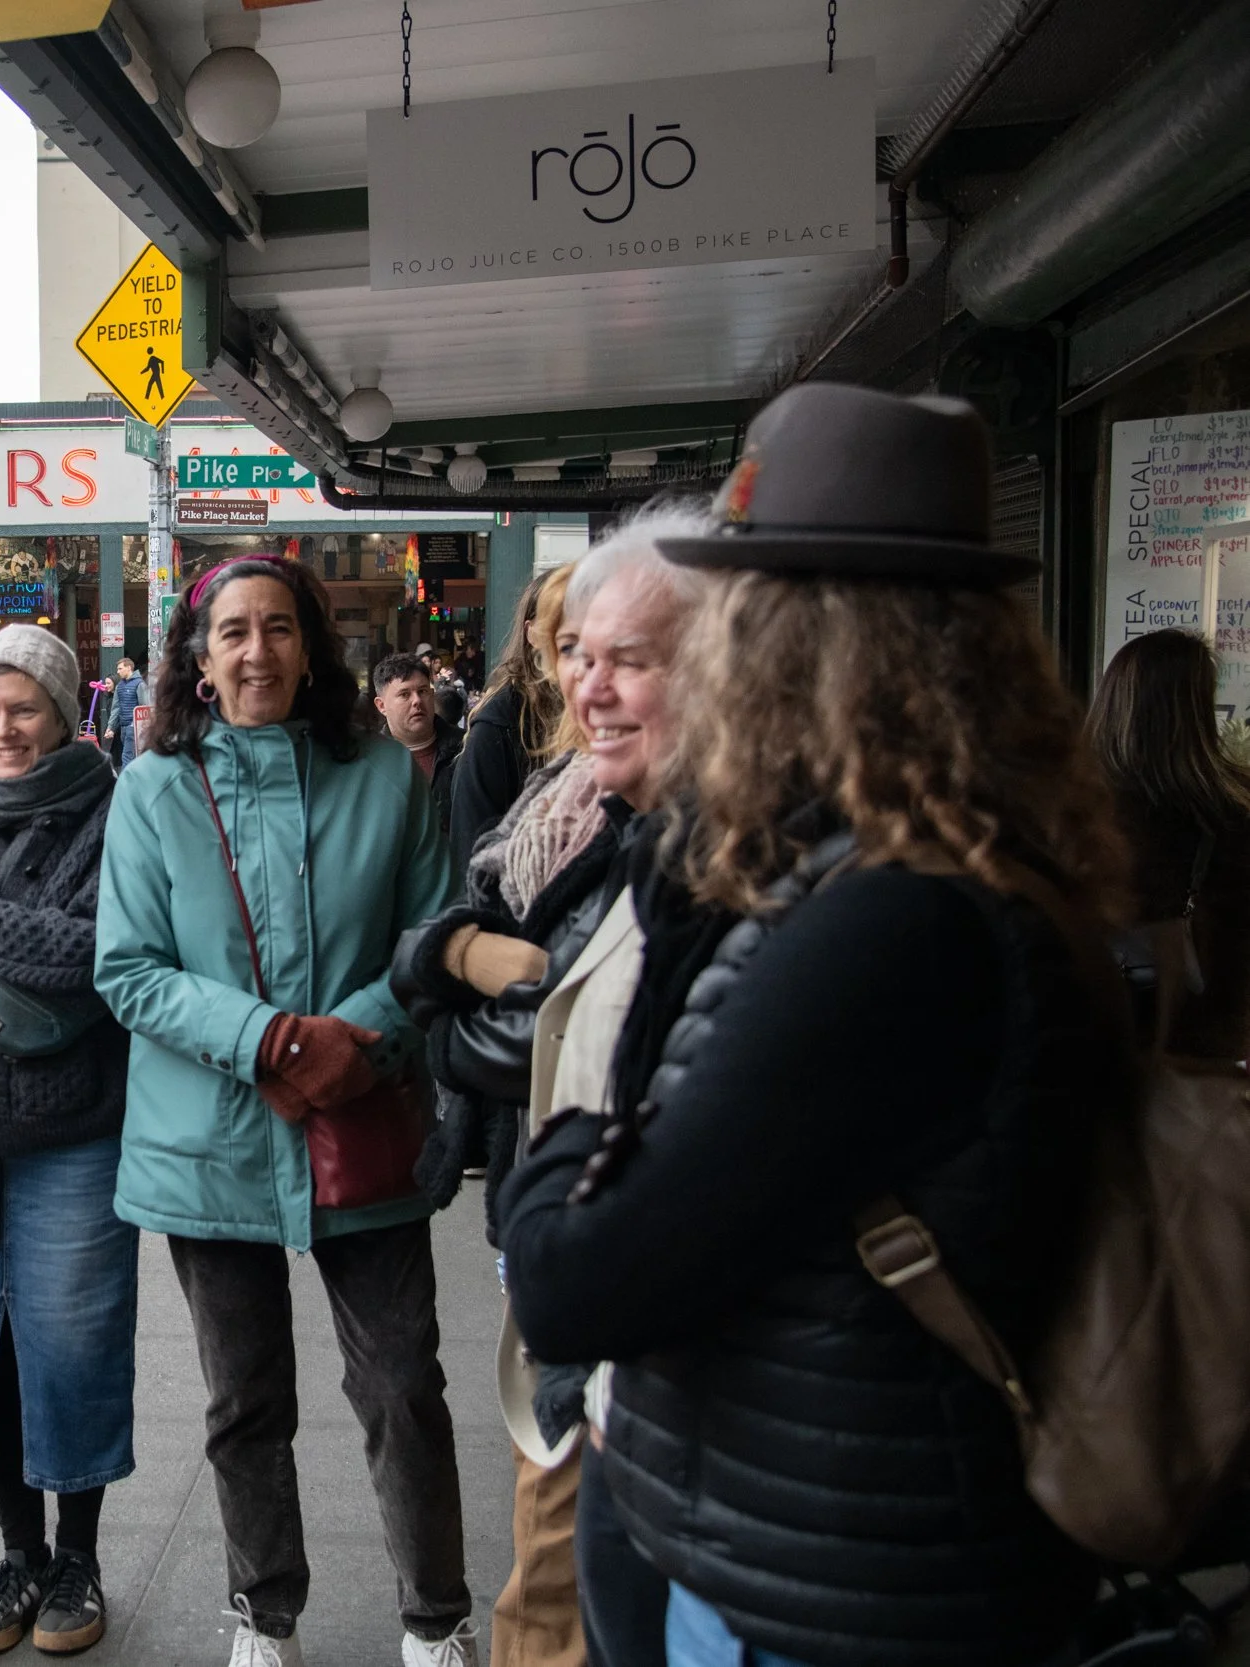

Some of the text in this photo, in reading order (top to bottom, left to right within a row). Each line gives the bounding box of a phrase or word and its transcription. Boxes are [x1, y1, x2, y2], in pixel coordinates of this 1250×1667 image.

[392, 222, 852, 276] ROJO JUICE CO. 1500B PIKE PLACE
[130, 273, 176, 295] YIELD
[143, 297, 162, 316] TO
[127, 420, 140, 450] Pike
[186, 458, 239, 484] Pike
[180, 510, 265, 521] Pike Place Market
[1127, 450, 1151, 562] SPECIAL
[1152, 538, 1202, 554] GINGER
[1123, 588, 1145, 641] TEA
[1148, 600, 1199, 611] COCONUT
[137, 709, 150, 719] NO
